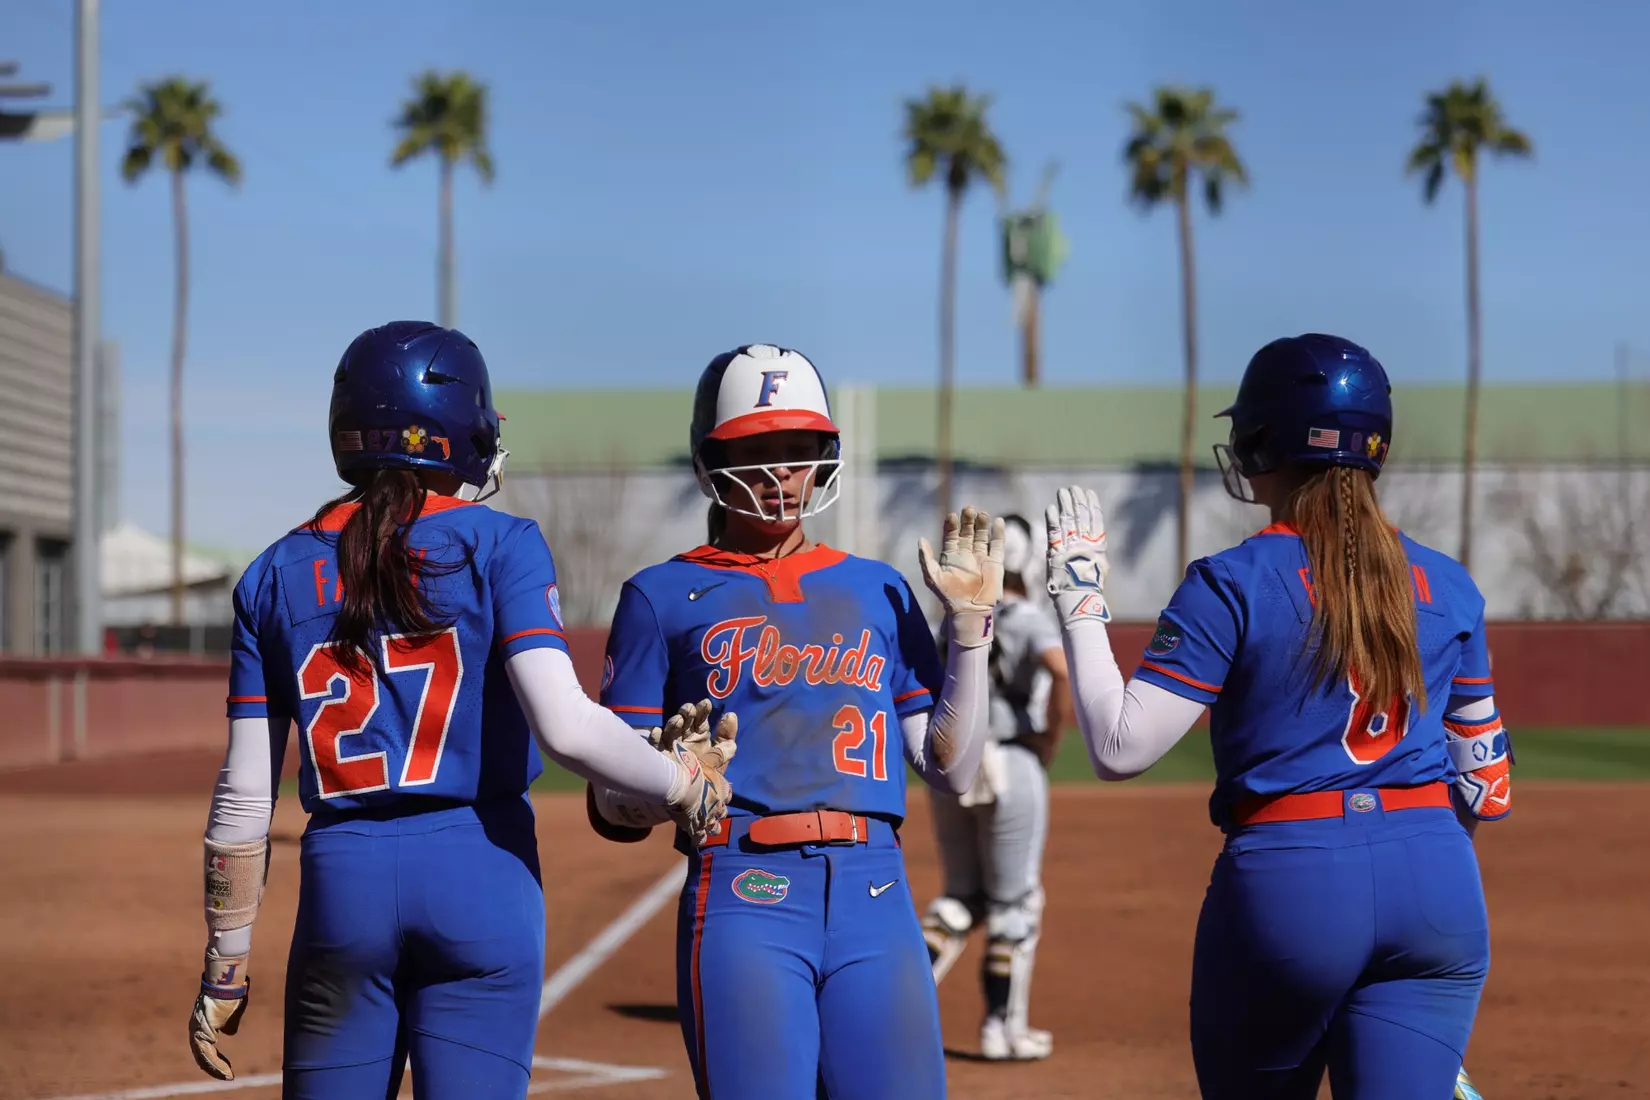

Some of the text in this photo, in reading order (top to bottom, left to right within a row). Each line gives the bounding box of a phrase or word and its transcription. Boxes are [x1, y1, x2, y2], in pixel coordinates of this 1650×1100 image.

[753, 371, 788, 408] F
[367, 429, 397, 451] 27
[701, 614, 886, 699] Florida
[981, 614, 992, 639] F
[296, 627, 464, 800] 27
[831, 704, 888, 781] 21
[1341, 657, 1412, 765] 8
